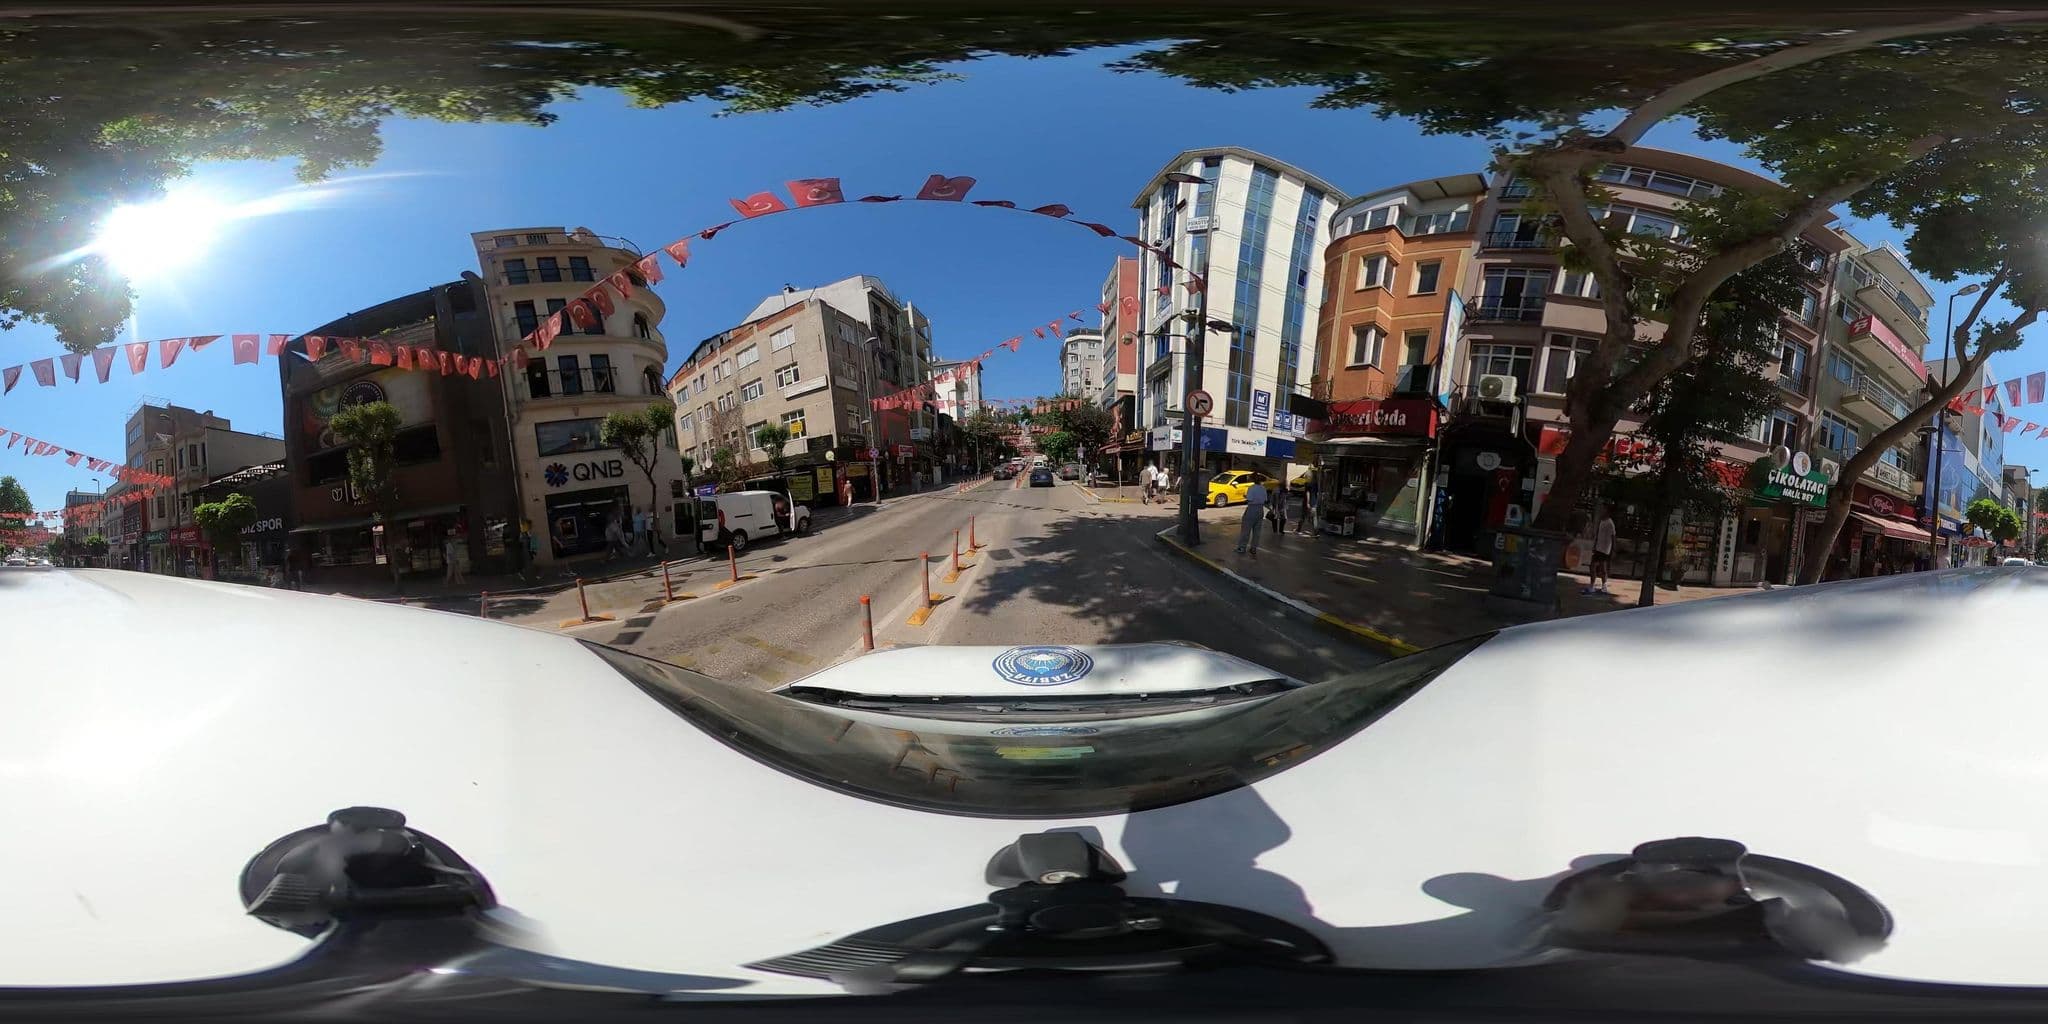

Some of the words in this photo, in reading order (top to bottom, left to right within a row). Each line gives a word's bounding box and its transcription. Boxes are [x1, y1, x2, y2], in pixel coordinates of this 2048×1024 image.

[573, 459, 624, 482] QNB
[1768, 469, 1827, 496] ÇİKOLATACI
[1801, 493, 1815, 502] BEY
[1011, 671, 1072, 684] ZABITA
